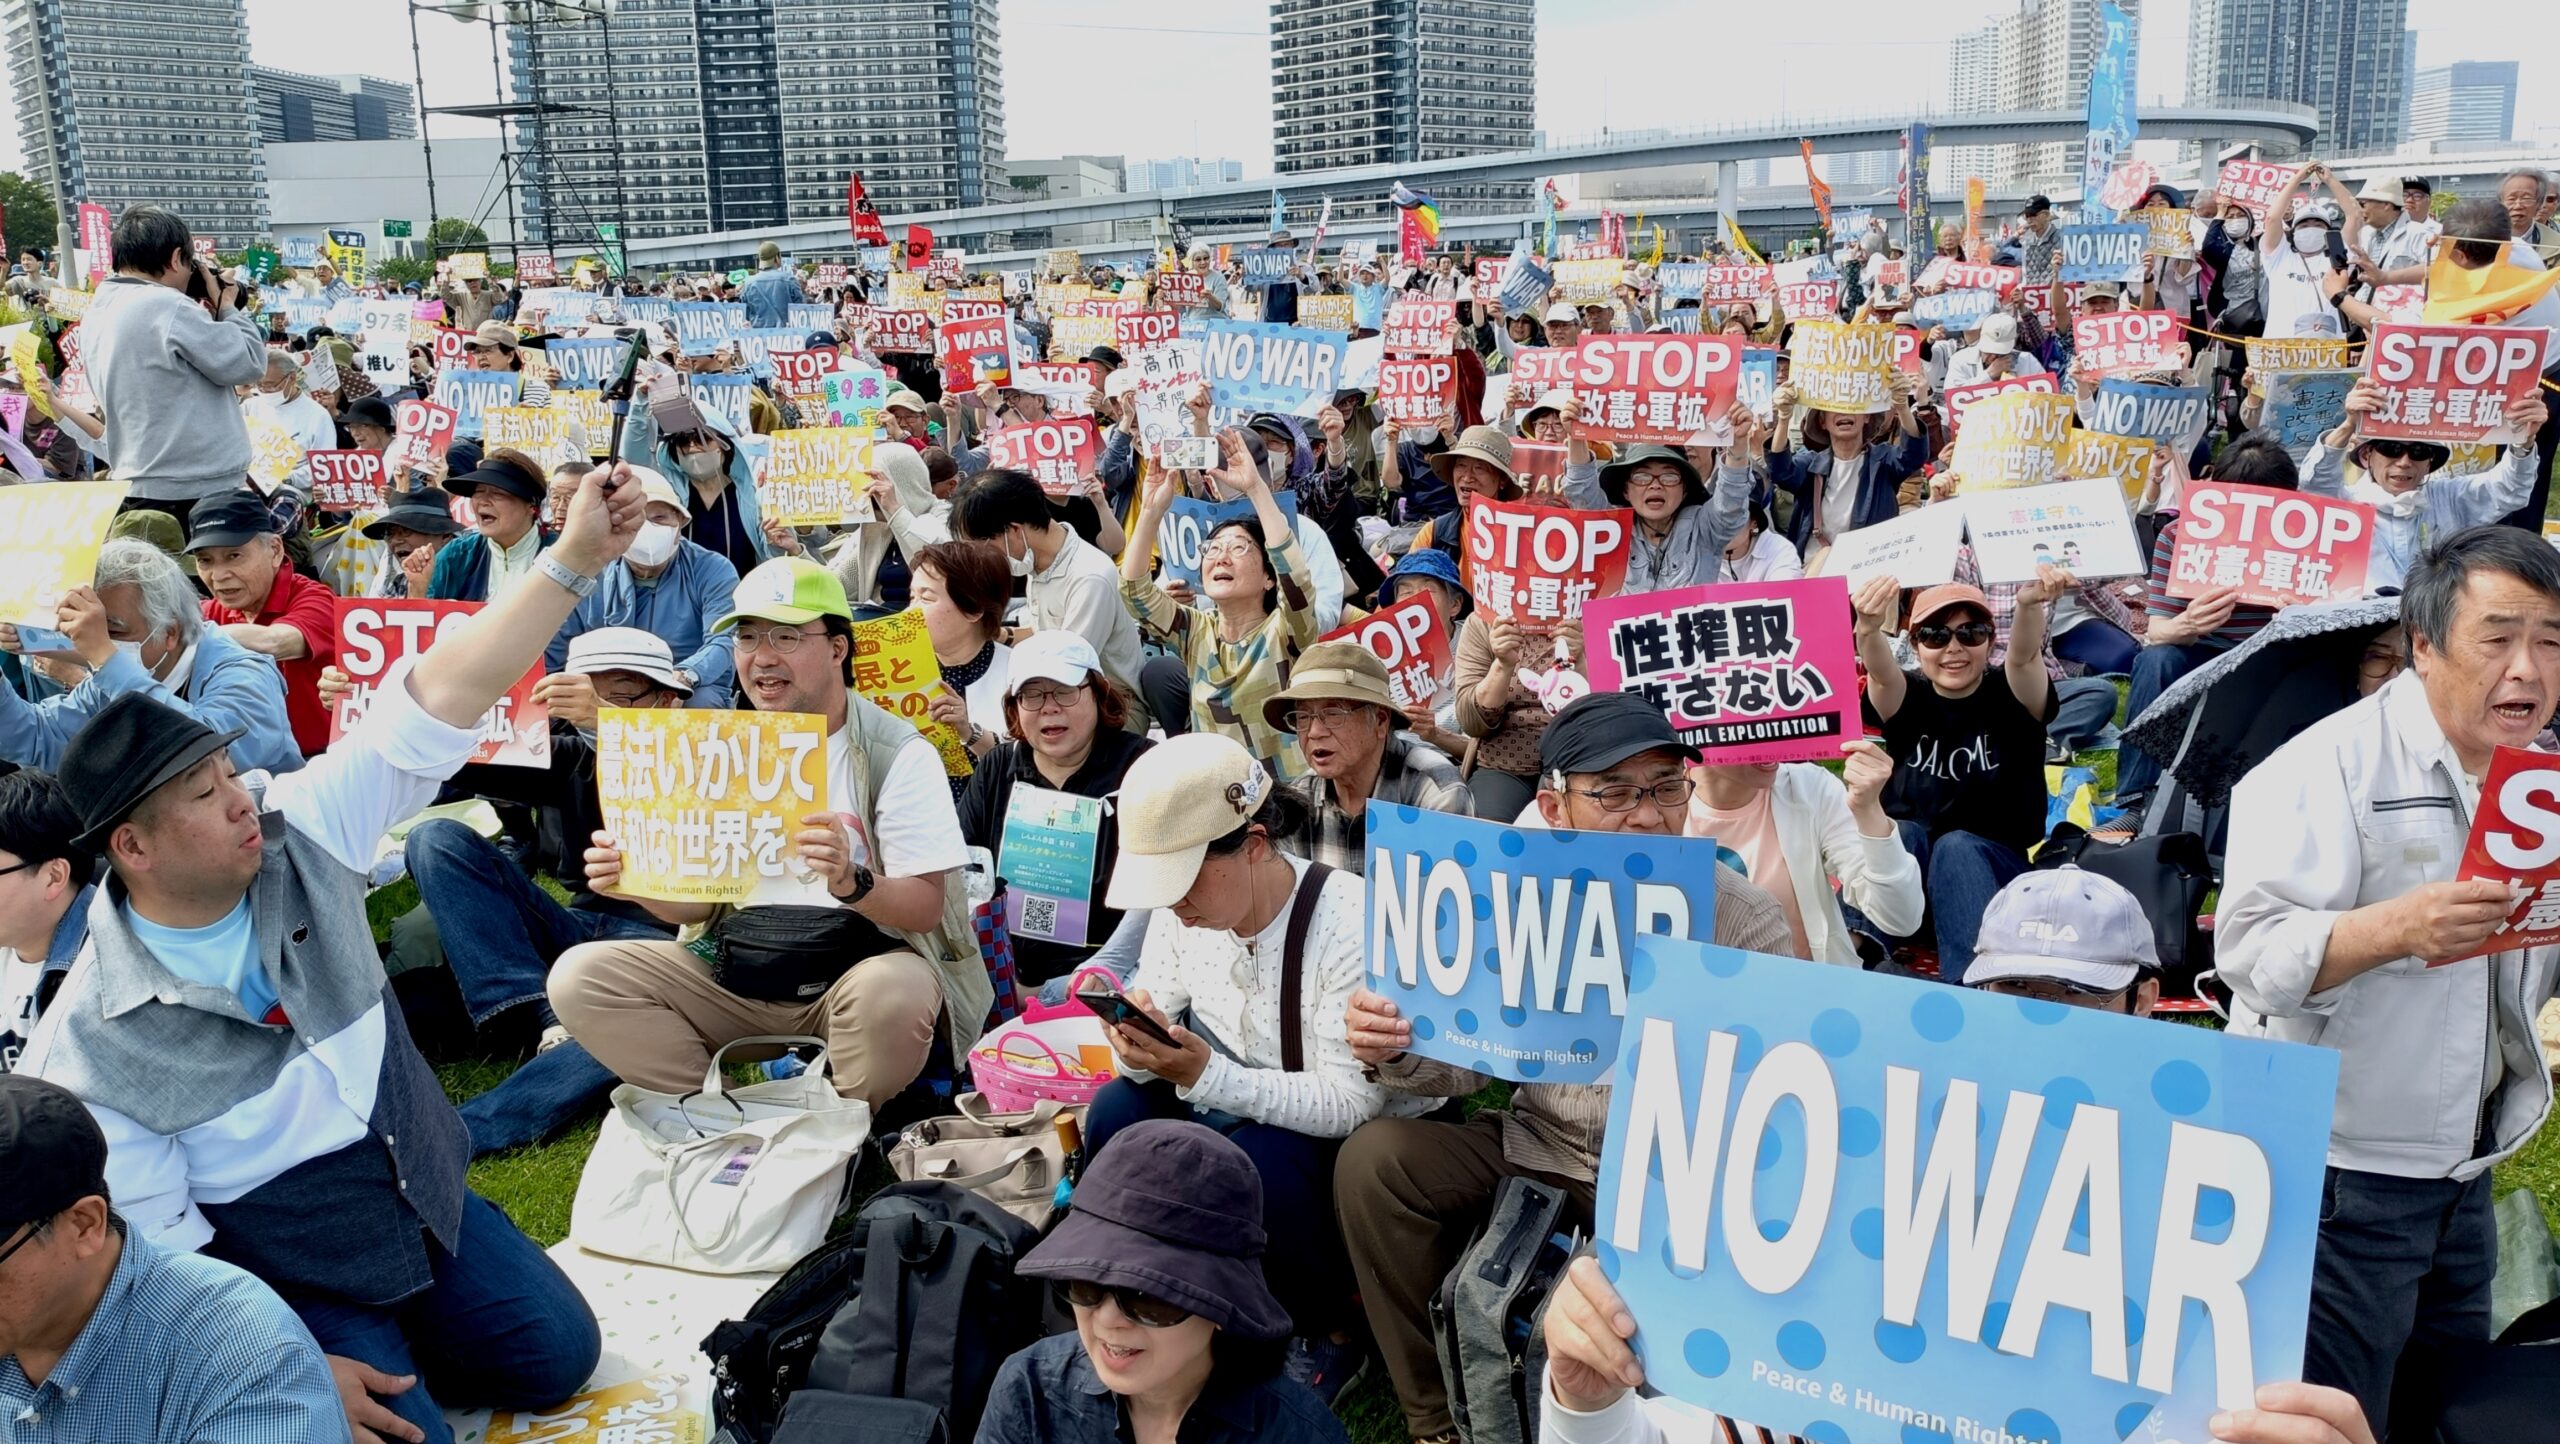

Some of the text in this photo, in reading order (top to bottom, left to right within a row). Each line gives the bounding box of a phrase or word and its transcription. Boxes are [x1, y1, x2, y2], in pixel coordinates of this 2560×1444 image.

[2225, 162, 2295, 189] STOP
[1832, 219, 1848, 234] NO
[193, 239, 213, 253] OP
[282, 241, 316, 258] NO WAR
[861, 251, 873, 263] NO
[2062, 233, 2142, 266] NO WAR
[519, 256, 552, 268] STOP
[820, 265, 847, 276] STOP
[929, 259, 957, 271] STOP
[1243, 254, 1292, 275] NO WAR
[1708, 266, 1769, 283] STOP
[1882, 262, 1900, 273] NO
[1018, 278, 1029, 293] 9
[1160, 274, 1202, 290] STOP
[1504, 267, 1546, 308] WAR
[1658, 268, 1678, 288] NO
[1878, 273, 1906, 285] WAR
[1945, 264, 2015, 291] STOP
[260, 288, 277, 303] NO
[1779, 286, 1834, 307] STOP
[1914, 290, 1991, 318] NO WAR
[365, 311, 408, 330] 97条
[624, 303, 669, 322] NO WAR
[726, 308, 743, 330] AR
[789, 309, 833, 331] NO WAR
[848, 304, 872, 317] STO
[872, 313, 925, 333] STOP
[944, 303, 1003, 323] STOP
[1388, 304, 1453, 328] STOP
[682, 309, 729, 341] WAR
[1117, 314, 1177, 342] STOP
[2076, 314, 2171, 348] STOP
[433, 328, 477, 357] TOP
[741, 336, 764, 363] NO
[953, 329, 1005, 351] WAR
[366, 354, 396, 373] 推し
[550, 346, 617, 381] NO WA
[772, 351, 835, 379] STOP
[1143, 347, 1186, 375] 高市
[1204, 332, 1337, 393] NO WAR
[1516, 352, 1577, 380] STO
[1580, 340, 1731, 388] STOP
[2249, 341, 2345, 369] 憲法いかして
[2377, 332, 2538, 385] STOP
[1381, 363, 1451, 395] STOP
[1737, 371, 1767, 402] AR
[433, 381, 514, 418] NO WAR
[713, 383, 750, 419] WAR
[1381, 396, 1443, 419] 改憲・軍拡
[1578, 388, 1708, 432] 改憲・軍拡
[2094, 390, 2198, 436] NO WAR
[2292, 388, 2343, 411] 憲法
[2370, 386, 2508, 428] 改憲・軍拡
[403, 404, 450, 437] OP
[2285, 410, 2334, 428] 改悪
[2408, 428, 2427, 436] Peace
[2457, 430, 2480, 438] Rights!
[990, 426, 1086, 470] STOP
[311, 455, 380, 482] STOP
[1516, 472, 1565, 495] EAC
[763, 478, 855, 518] 平和な世界を
[2009, 504, 2084, 525] 憲法守れ
[2184, 489, 2362, 555] STOP
[1158, 511, 1202, 572] NO
[1471, 503, 1622, 574] STOP
[2175, 543, 2334, 601] 改憲・軍拡
[1473, 562, 1594, 621] 改憲・軍拡
[1614, 602, 1800, 679] 性搾取
[1624, 664, 1830, 720] 許さない
[1718, 716, 1829, 743] EXPLOITATION
[600, 721, 819, 802] 憲法いかして
[1907, 734, 2000, 782] SALOME
[604, 807, 786, 880] 平和な世界を
[705, 884, 743, 896] Rights!
[1372, 846, 1690, 1017] NO WAR
[2019, 921, 2080, 944] FILA
[2520, 933, 2559, 945] Peace
[1445, 1030, 1593, 1065] Peace & Human Rights!
[1612, 1016, 2273, 1410] NO WAR
[1751, 1359, 2050, 1444] Peace & Human Rights!
